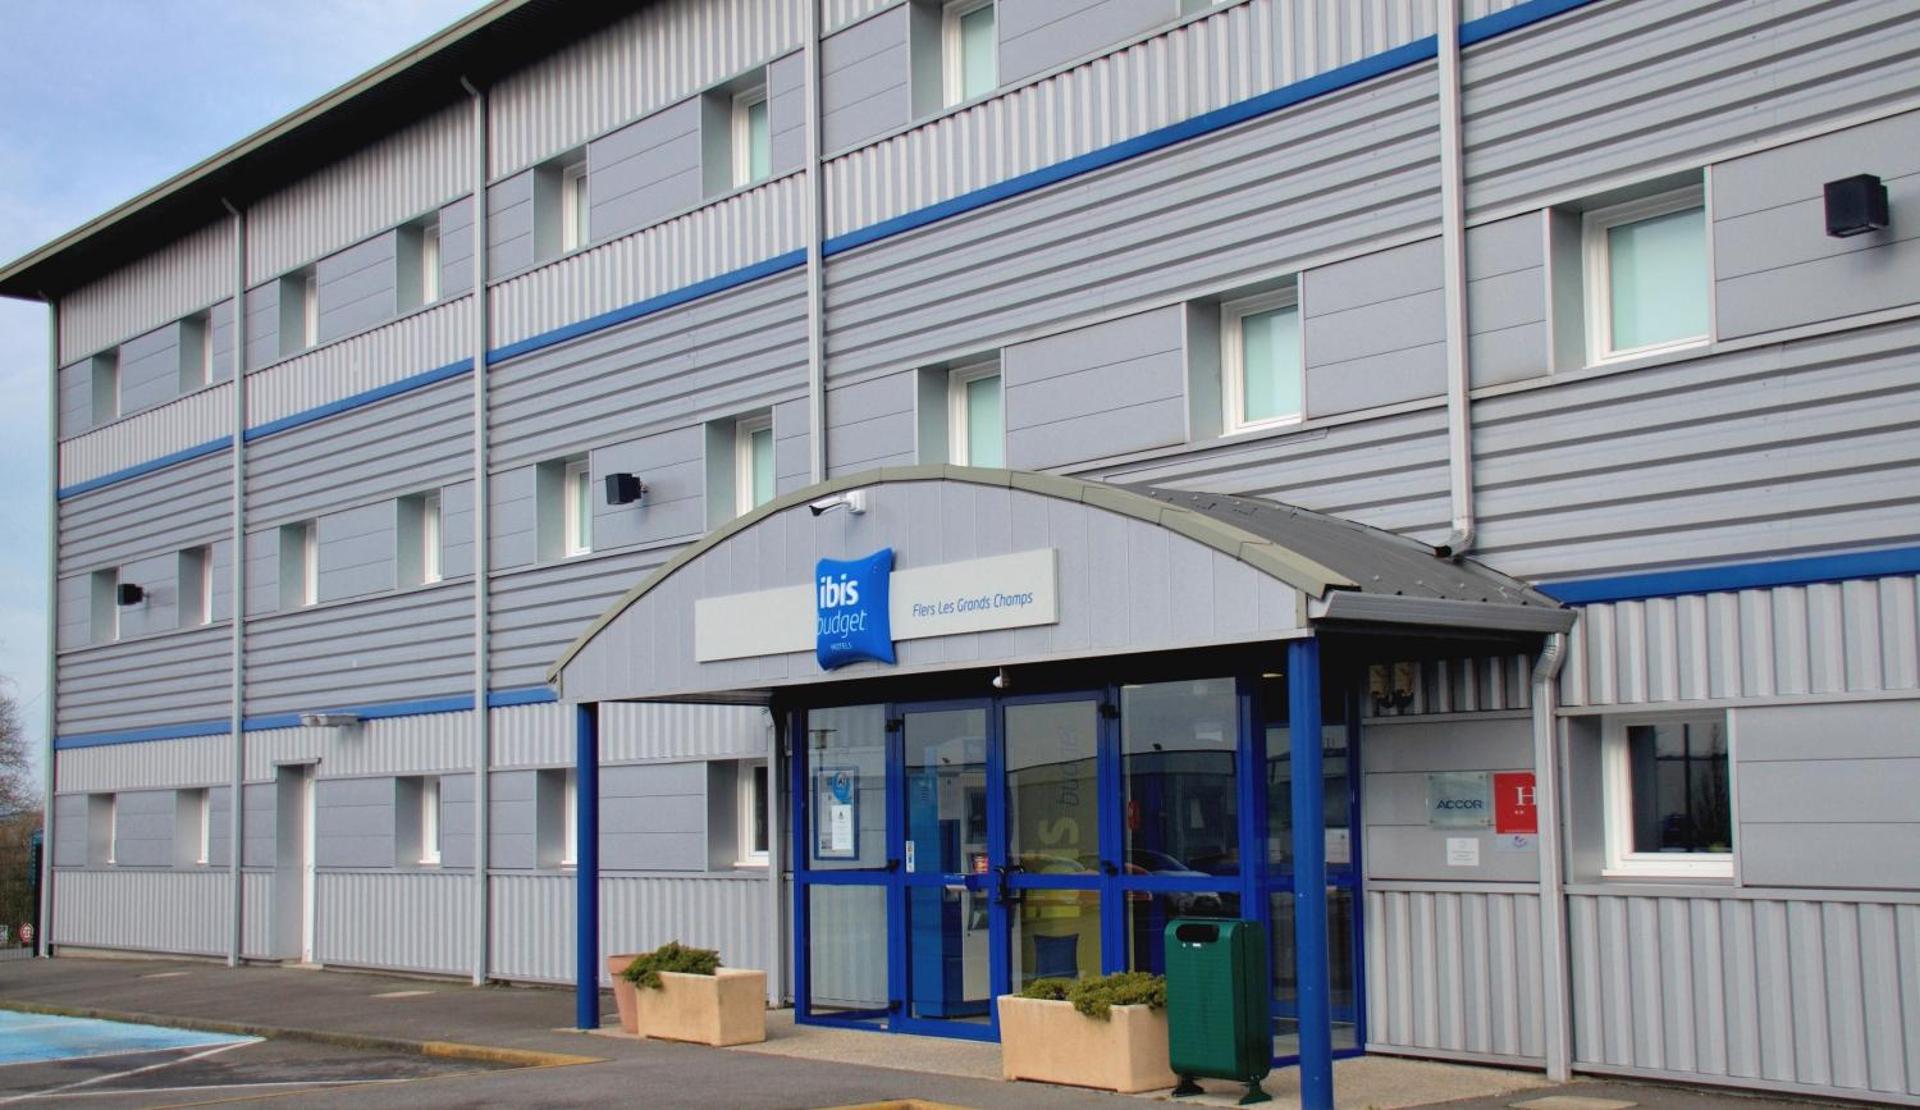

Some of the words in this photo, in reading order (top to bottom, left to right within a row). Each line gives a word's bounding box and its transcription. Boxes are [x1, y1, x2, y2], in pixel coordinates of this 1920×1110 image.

[820, 573, 859, 609] ibis
[938, 600, 955, 615] Les
[957, 596, 991, 614] Grands
[993, 592, 1033, 609] Champs
[1437, 799, 1483, 810] ACCOR
[1514, 786, 1537, 806] H
